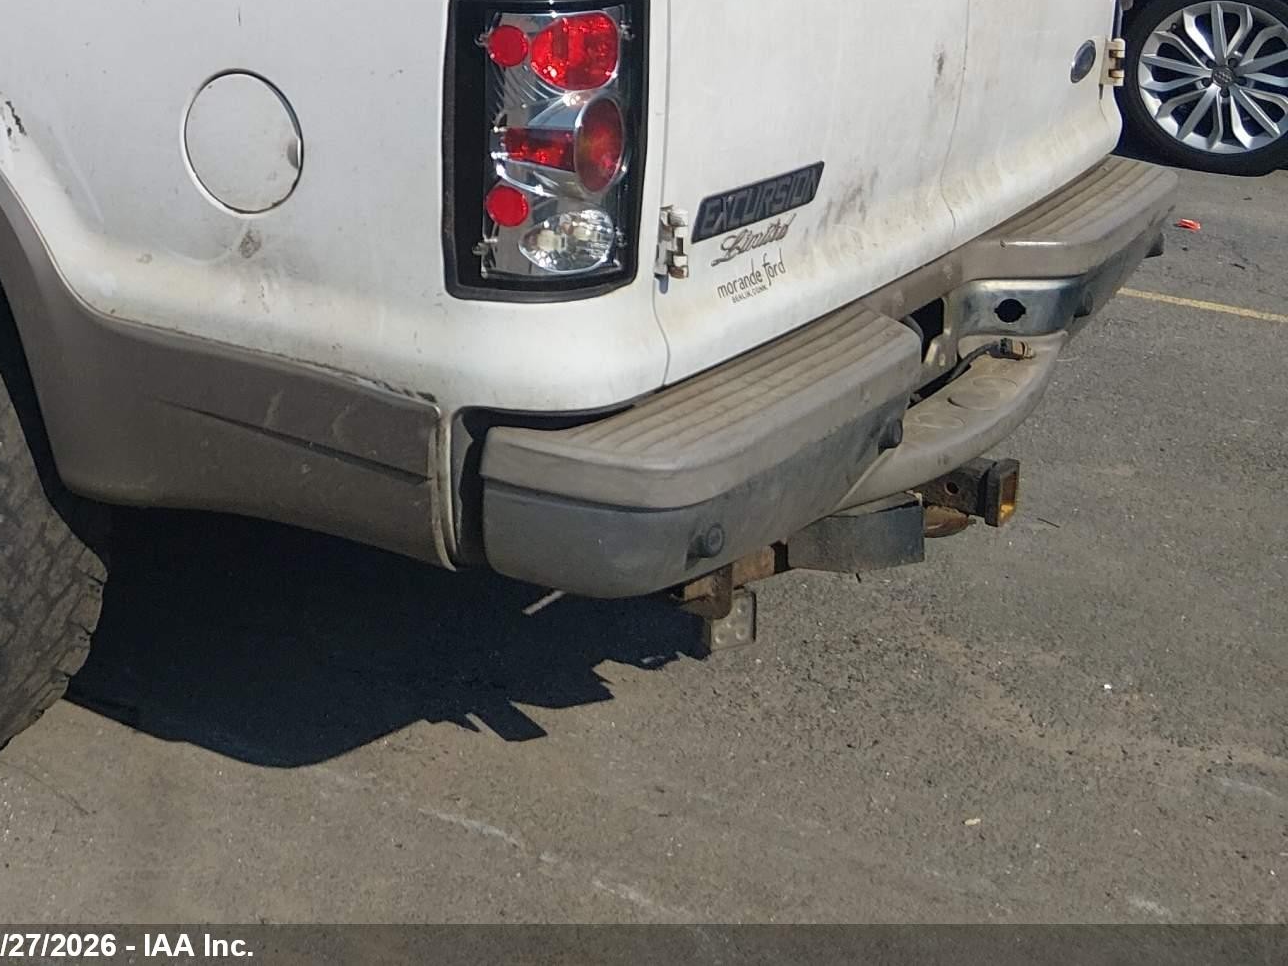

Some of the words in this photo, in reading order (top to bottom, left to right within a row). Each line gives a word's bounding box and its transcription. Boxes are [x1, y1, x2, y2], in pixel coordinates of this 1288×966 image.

[701, 168, 818, 234] EXCURSION
[711, 213, 797, 267] Limited
[717, 258, 762, 299] morande
[762, 247, 787, 287] ford
